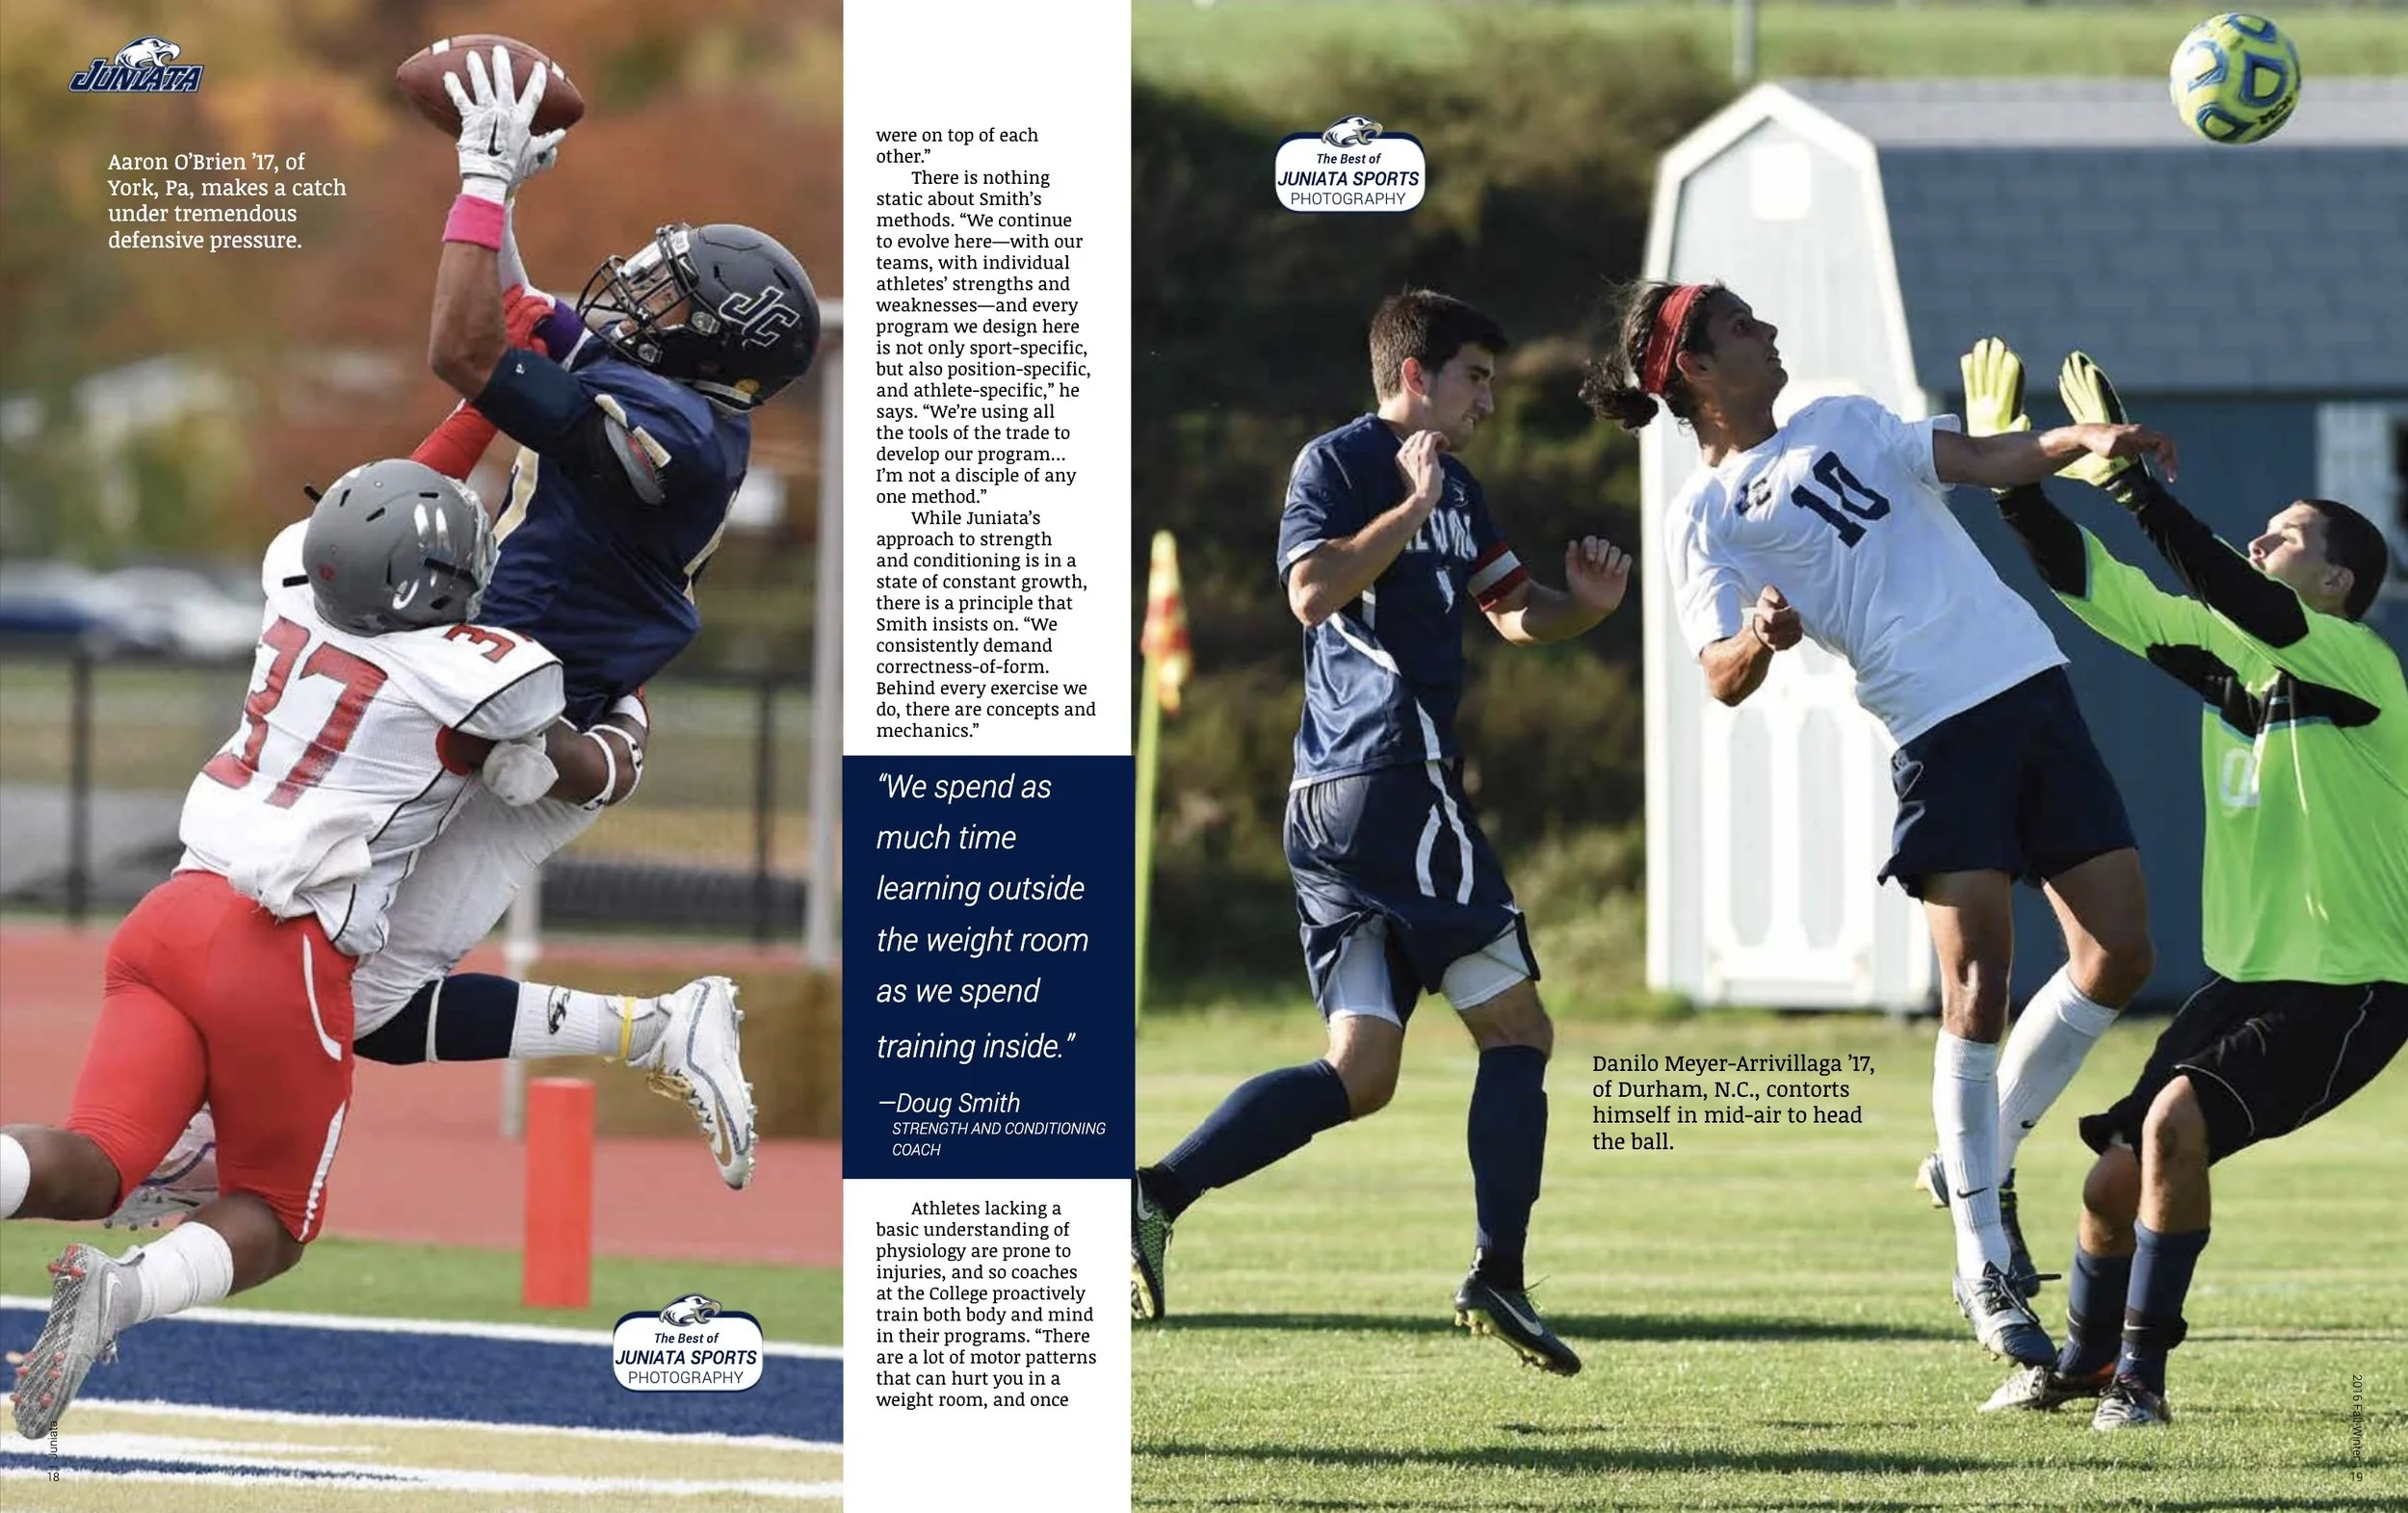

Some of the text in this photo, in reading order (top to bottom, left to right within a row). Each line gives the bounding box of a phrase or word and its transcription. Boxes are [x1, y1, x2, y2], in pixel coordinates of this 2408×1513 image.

[876, 126, 1039, 146] were on top of each
[877, 148, 931, 164] other.”
[911, 170, 1051, 189] There is nothing
[876, 233, 1084, 248] to evolve here—with our
[877, 275, 1070, 295] athletes’ strengths and
[719, 286, 799, 348] JC
[876, 318, 1080, 338] program we design here
[876, 360, 1091, 380] but also position-specific,
[877, 404, 1055, 423] says. “We’re using all
[877, 446, 1065, 465] develop our program...
[876, 488, 987, 504] one method.”
[1790, 450, 1892, 550] 10
[910, 509, 1041, 525] While Juniata’s
[877, 552, 1077, 571] and conditioning is in a
[876, 594, 1073, 613] there is a principle that
[876, 637, 1053, 657] consistently demand
[877, 658, 1049, 674] correctness-of-form.
[200, 615, 389, 809] 37
[876, 701, 1096, 720] do, there are concepts and
[877, 722, 980, 738] mechanics.”
[878, 772, 1052, 805] “We spend as
[876, 822, 1017, 850] much time
[877, 874, 1086, 907] learning outside
[877, 926, 1088, 959] the weight room
[876, 977, 1042, 1009] as we spend
[877, 1031, 1077, 1065] training inside.”
[878, 1091, 1020, 1118] —Doug Smith
[892, 1121, 1107, 1135] STRENGTH AND CONDITIONING
[892, 1142, 942, 1157] COACH
[910, 1200, 1062, 1219] Athletes lacking a
[876, 1221, 1070, 1240] basic understanding of
[877, 1264, 1078, 1283] injuries, and so coaches
[876, 1306, 1094, 1325] train both body and mind
[877, 1348, 1097, 1369] are a lot of motor patterns
[876, 1392, 1069, 1411] weight room, and once
